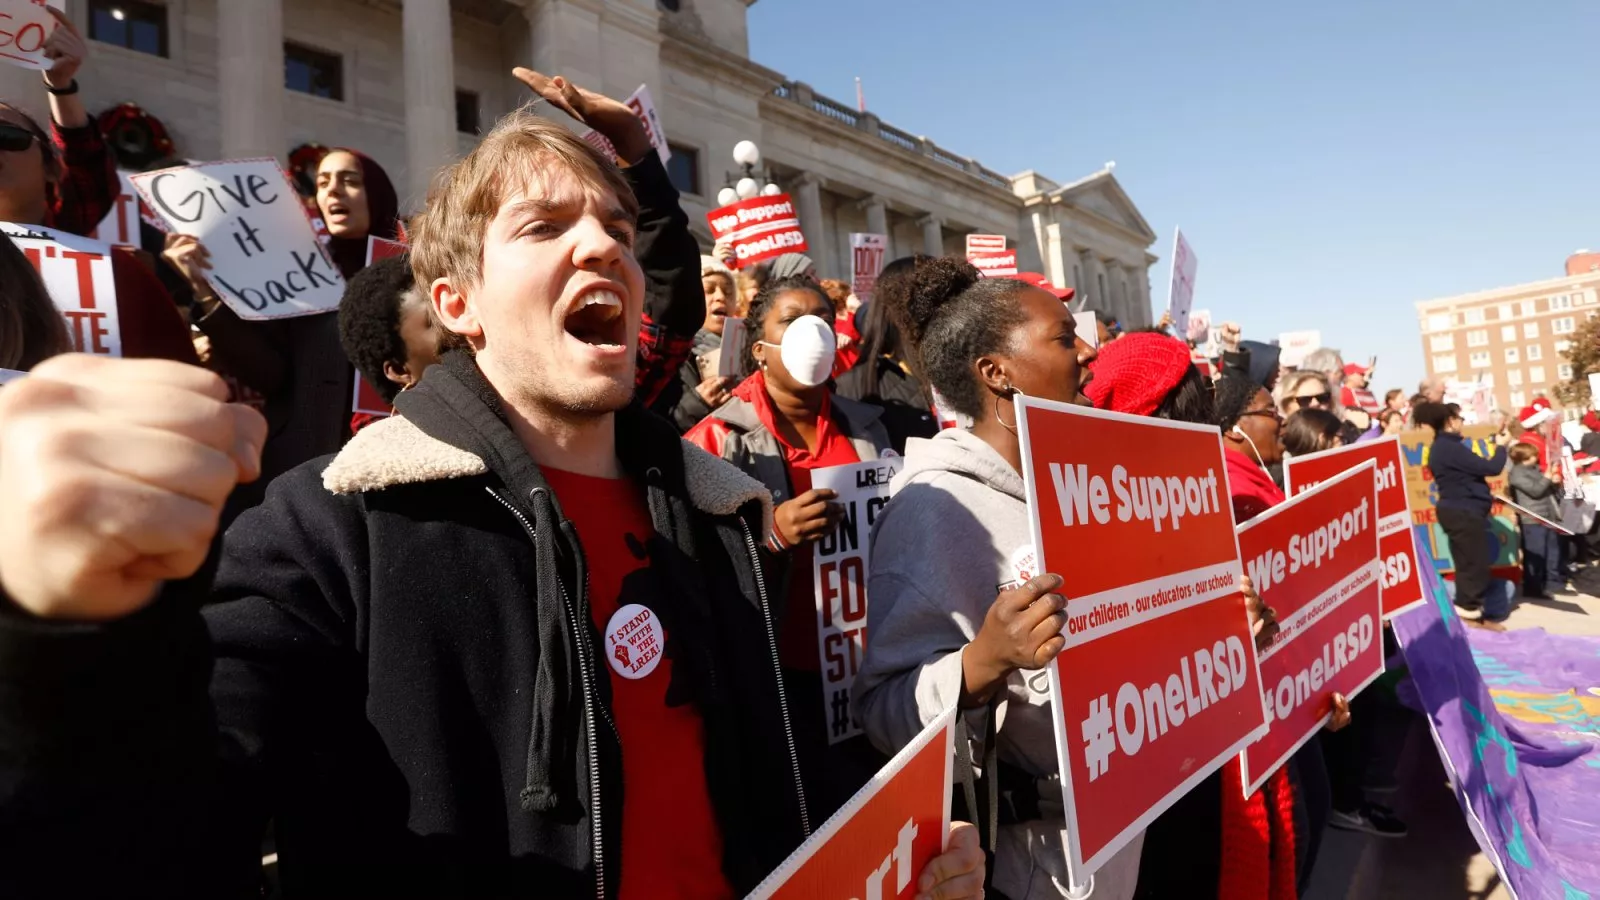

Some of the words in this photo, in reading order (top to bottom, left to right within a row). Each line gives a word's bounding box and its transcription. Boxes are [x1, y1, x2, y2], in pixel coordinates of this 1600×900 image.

[151, 173, 278, 223] Give
[712, 215, 738, 232] We
[737, 201, 793, 223] Support
[232, 216, 265, 257] it
[213, 240, 343, 311] back!
[855, 466, 897, 488] LREA
[1048, 462, 1111, 527] We
[1111, 464, 1220, 533] Support
[1246, 549, 1286, 596] We
[1288, 497, 1369, 574] Support
[1068, 613, 1088, 635] our
[1089, 598, 1130, 629] children
[1135, 594, 1151, 612] our
[1151, 580, 1192, 607] educators
[1195, 578, 1208, 593] our
[1207, 572, 1234, 592] schools
[1307, 594, 1338, 621] educators
[1349, 570, 1372, 592] schools
[609, 634, 618, 645] I
[616, 609, 651, 640] STAND
[627, 623, 653, 646] WITH
[637, 634, 656, 652] THE
[630, 644, 661, 674] LREA!
[824, 628, 867, 683] ST
[1081, 635, 1247, 783] #OneLRSD
